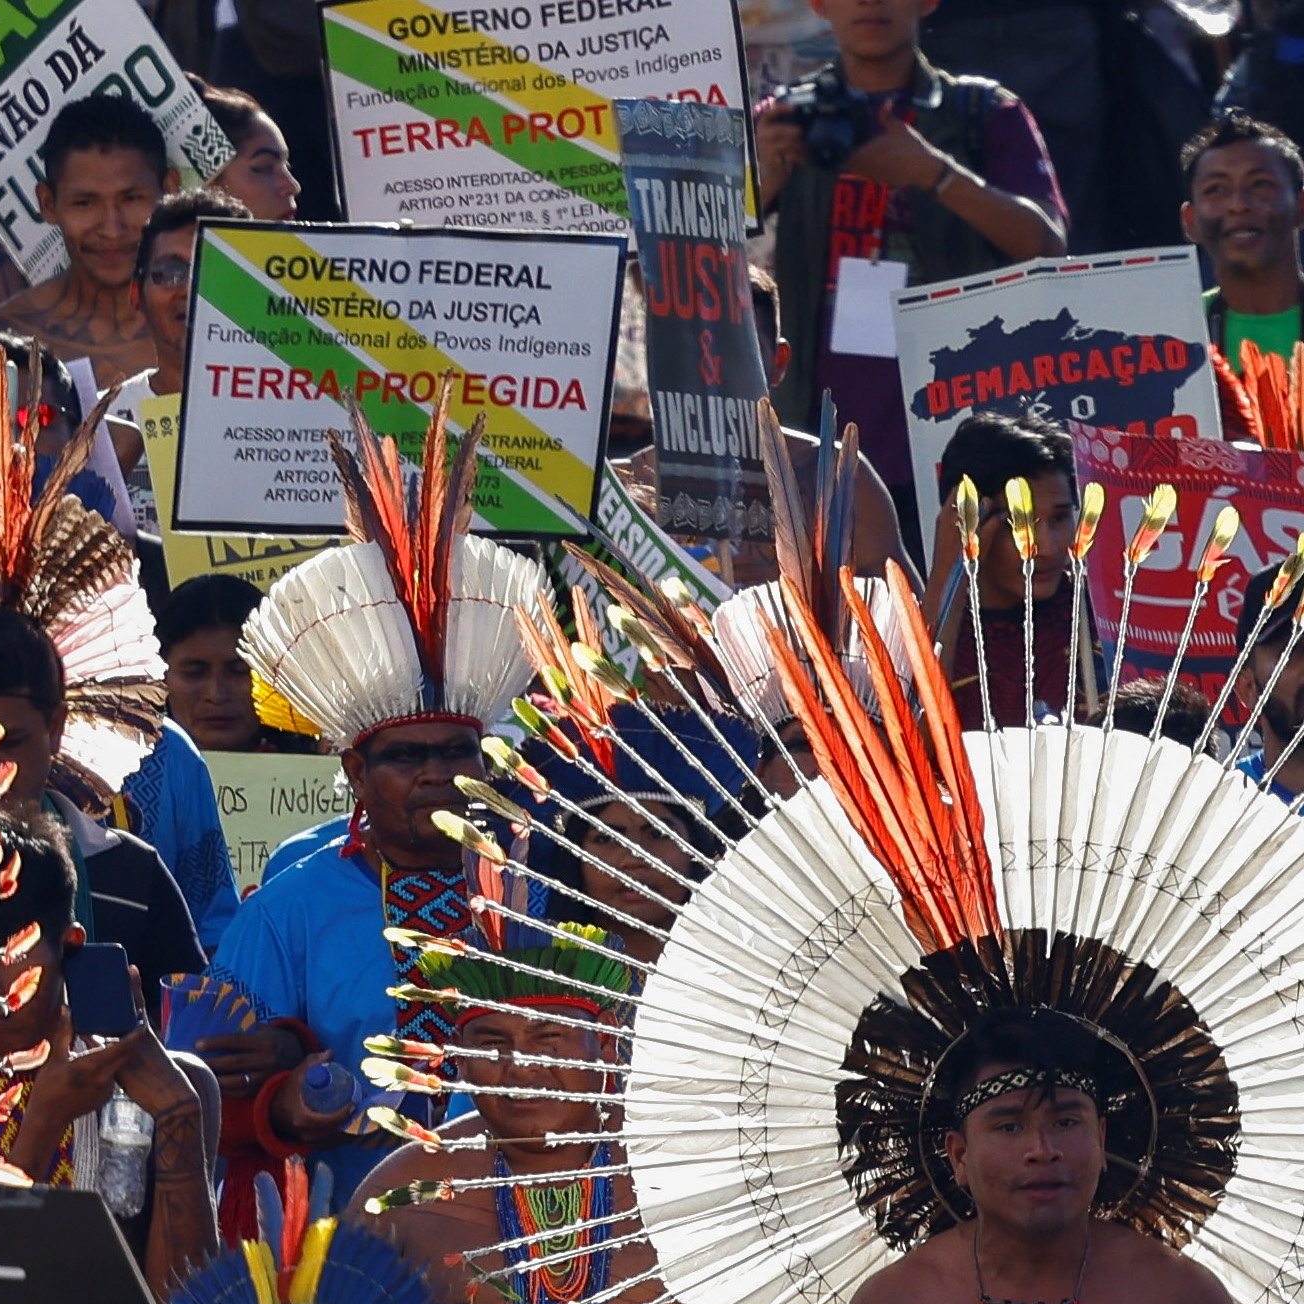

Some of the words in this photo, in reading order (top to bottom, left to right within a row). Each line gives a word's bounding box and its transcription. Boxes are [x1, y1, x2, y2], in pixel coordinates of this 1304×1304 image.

[389, 8, 532, 41] GOVERNO
[45, 18, 106, 94] DÁ
[398, 40, 530, 74] MINISTÉRIO
[538, 39, 569, 62] DA
[577, 24, 670, 59] JUSTIÇA
[347, 83, 440, 109] Fundação
[446, 72, 527, 97] Nacional
[533, 71, 566, 90] dos
[573, 63, 630, 86] Povos
[635, 46, 723, 77] Indígenas
[354, 117, 493, 157] TERRA
[384, 176, 444, 195] ACESSO
[447, 170, 544, 189] INTERDITADO
[266, 256, 410, 283] GOVERNO
[419, 260, 552, 290] FEDERAL
[266, 292, 401, 321] MINISTÉRIO
[409, 300, 437, 320] DA
[443, 300, 542, 327] JUSTIÇA
[208, 324, 301, 347] Fundação
[308, 328, 390, 349] Nacional
[396, 332, 427, 350] dos
[434, 331, 491, 352] Povos
[499, 334, 592, 358] Indígenas
[700, 330, 723, 385] &
[206, 364, 336, 400] TERRA
[926, 336, 1189, 416] DEMARCAÇÃO
